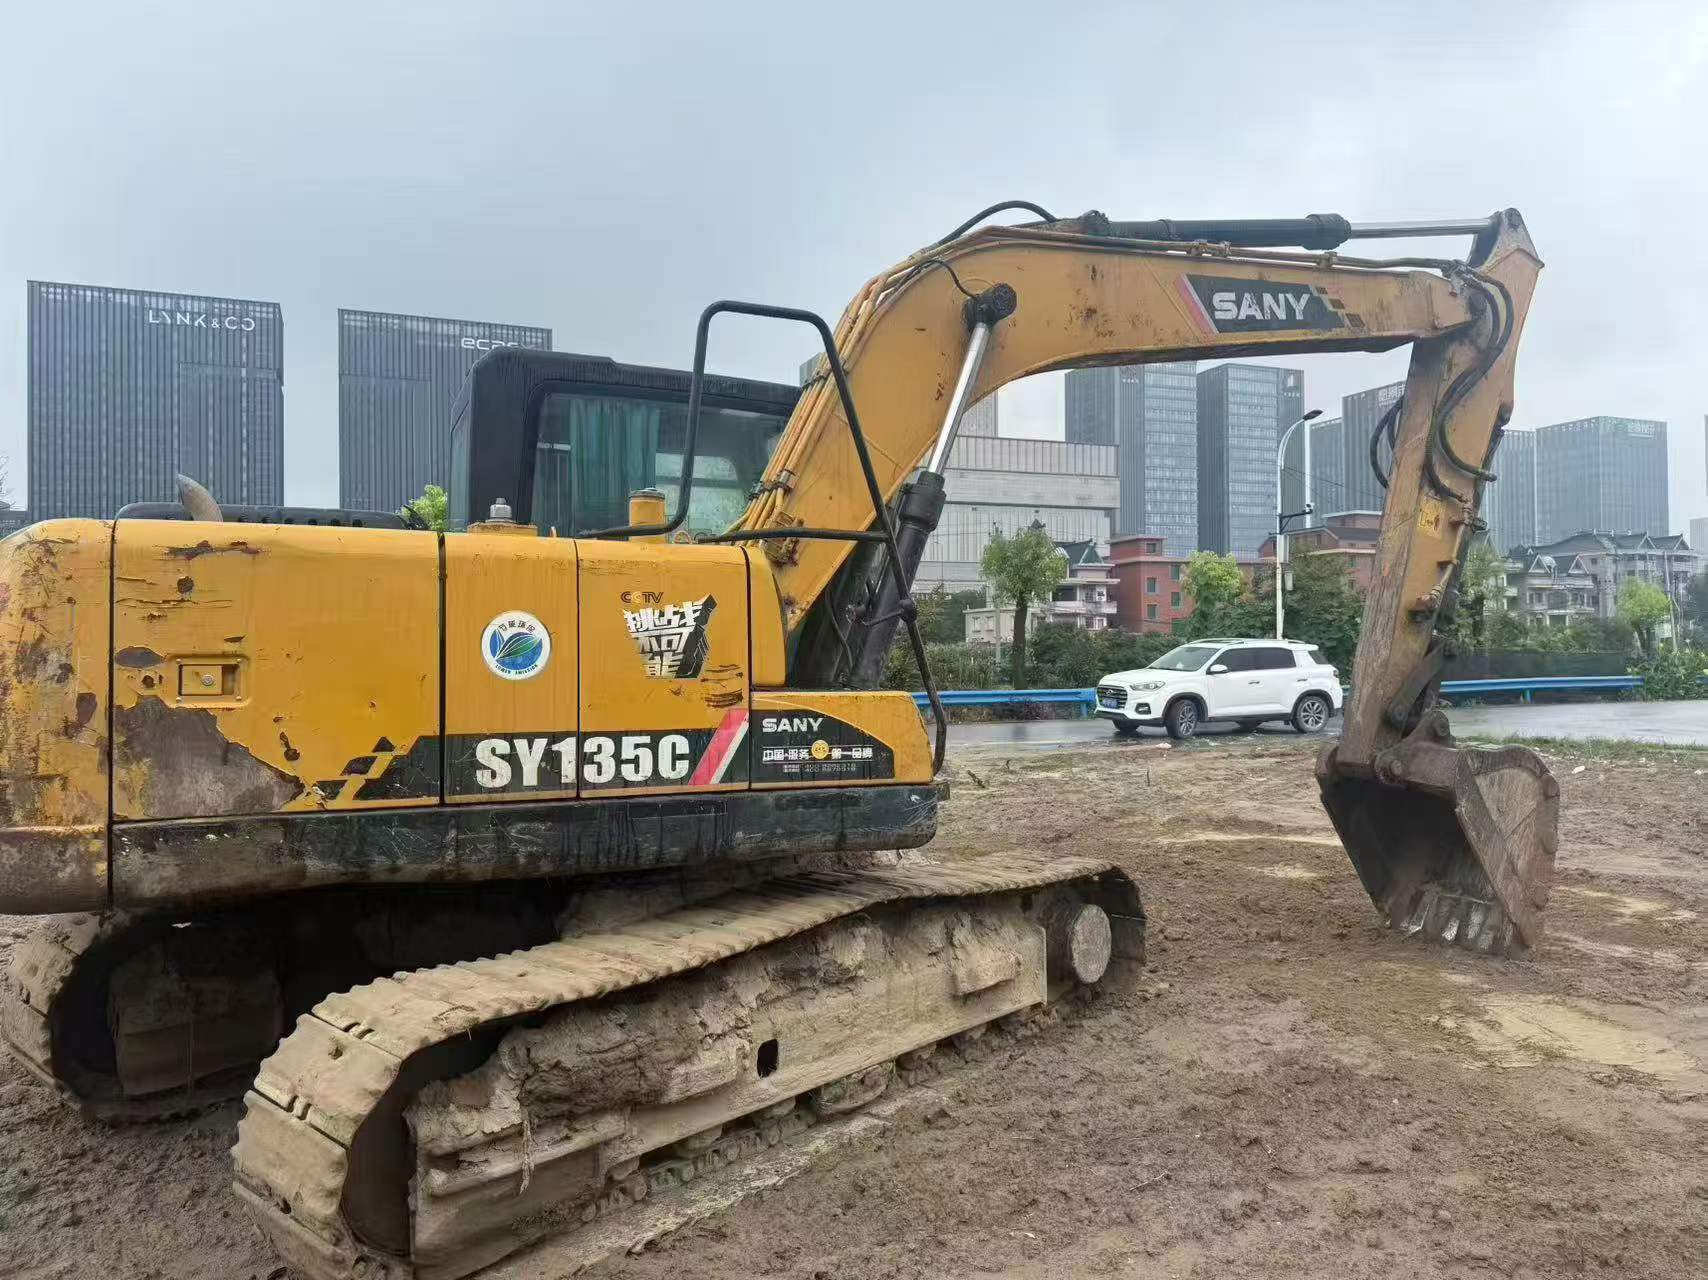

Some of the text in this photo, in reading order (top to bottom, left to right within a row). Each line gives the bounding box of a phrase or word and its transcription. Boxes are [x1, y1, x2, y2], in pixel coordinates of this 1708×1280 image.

[1212, 292, 1310, 320] SANY
[620, 591, 664, 604] CCTV
[762, 718, 824, 733] SANY
[475, 734, 690, 789] SY135C
